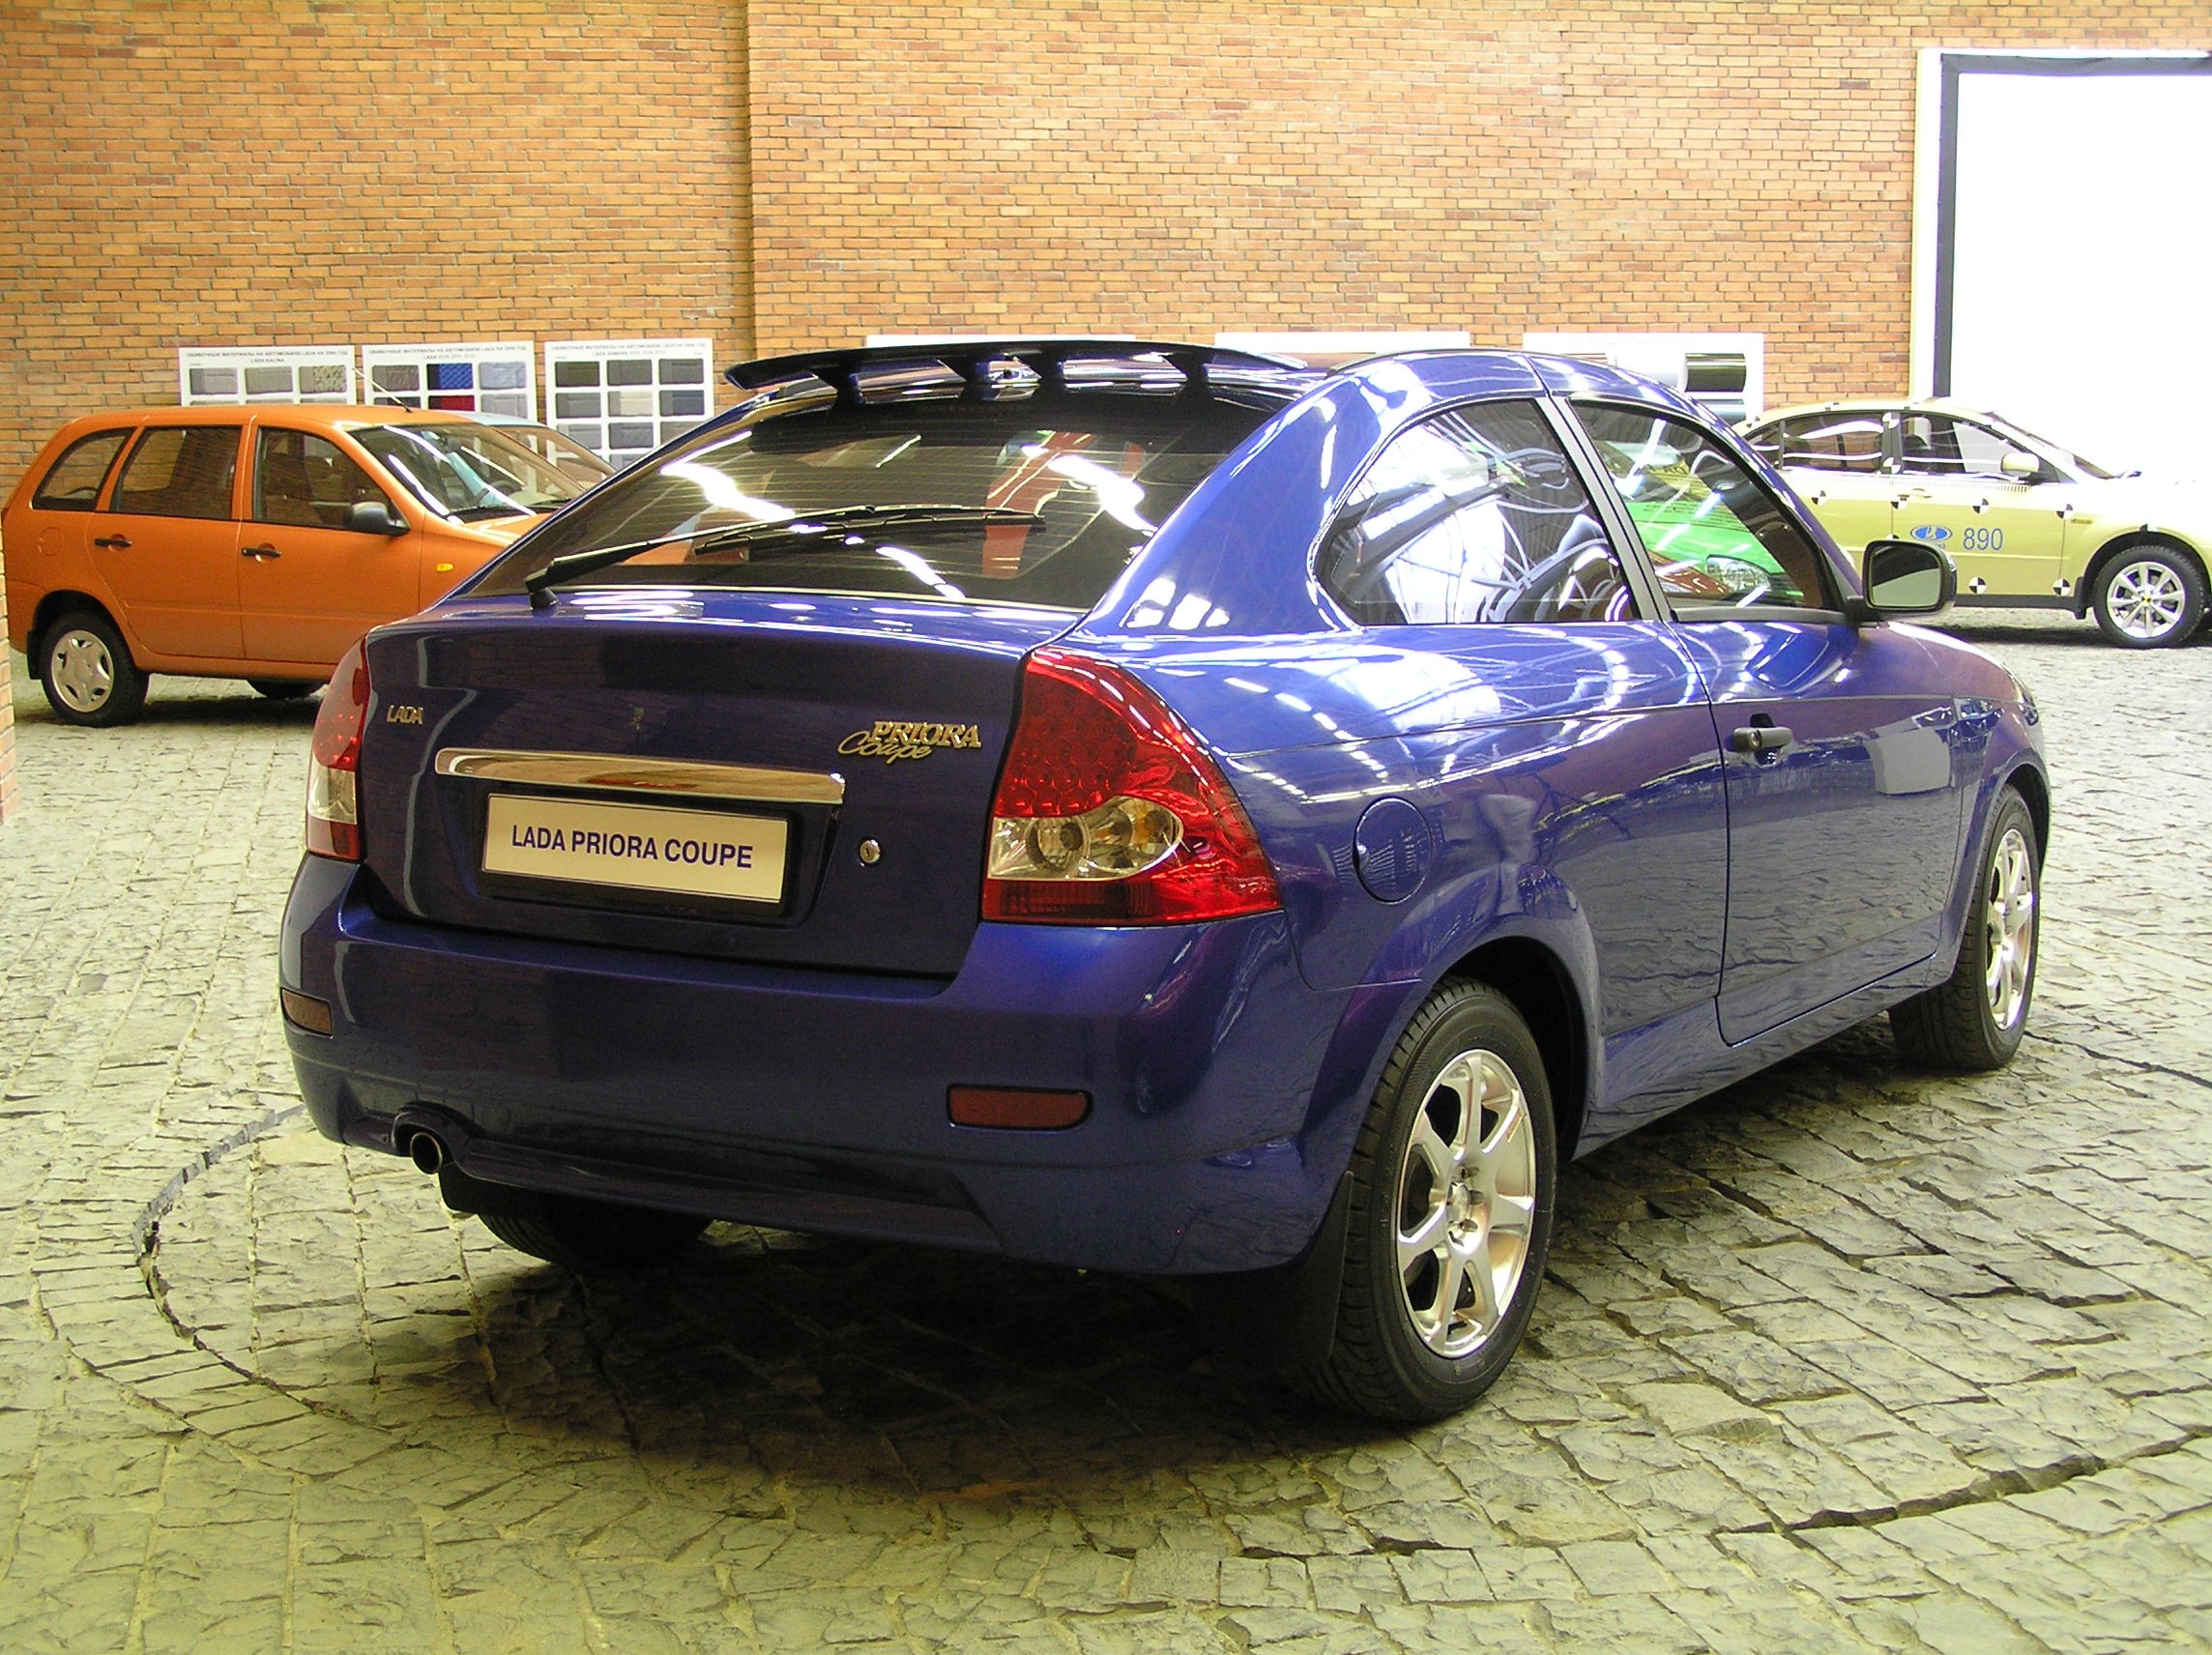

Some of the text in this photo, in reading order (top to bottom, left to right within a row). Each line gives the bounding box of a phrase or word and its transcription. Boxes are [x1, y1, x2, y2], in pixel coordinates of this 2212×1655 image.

[1963, 527, 2004, 551] 890
[387, 704, 424, 725] LADA
[837, 730, 933, 765] Coupe
[868, 720, 982, 749] PRIORA
[511, 824, 754, 869] LADA PRIORA COUPE
